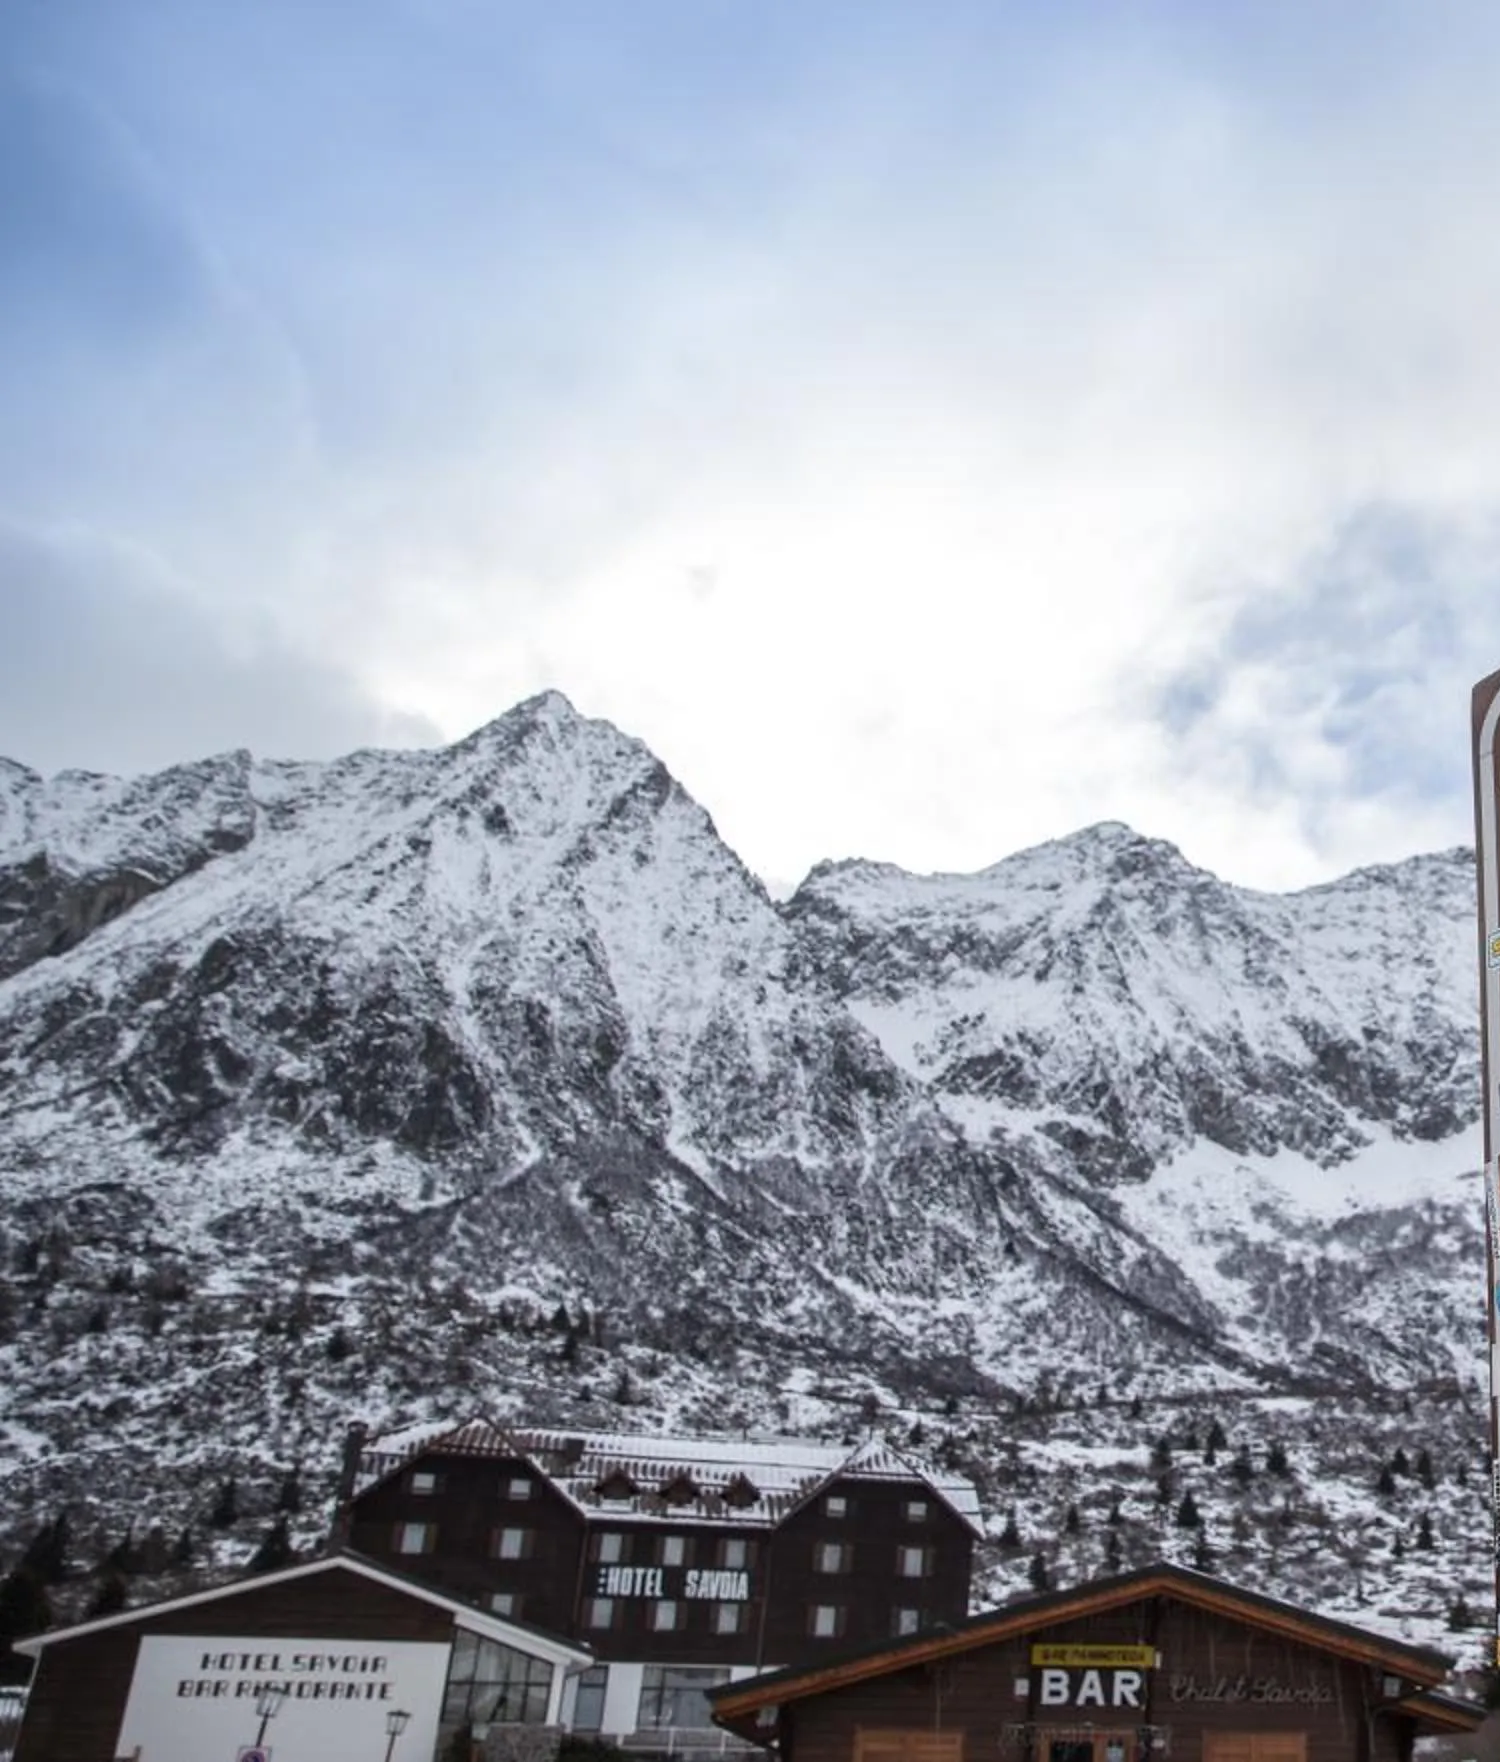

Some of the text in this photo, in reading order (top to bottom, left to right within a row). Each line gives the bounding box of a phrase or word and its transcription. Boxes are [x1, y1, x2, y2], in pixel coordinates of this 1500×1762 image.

[608, 1566, 749, 1600] HOTEL SAVOIA
[200, 1652, 389, 1674] HOTEL SAVOIA
[176, 1679, 230, 1699] BAR
[1039, 1668, 1144, 1708] BAR
